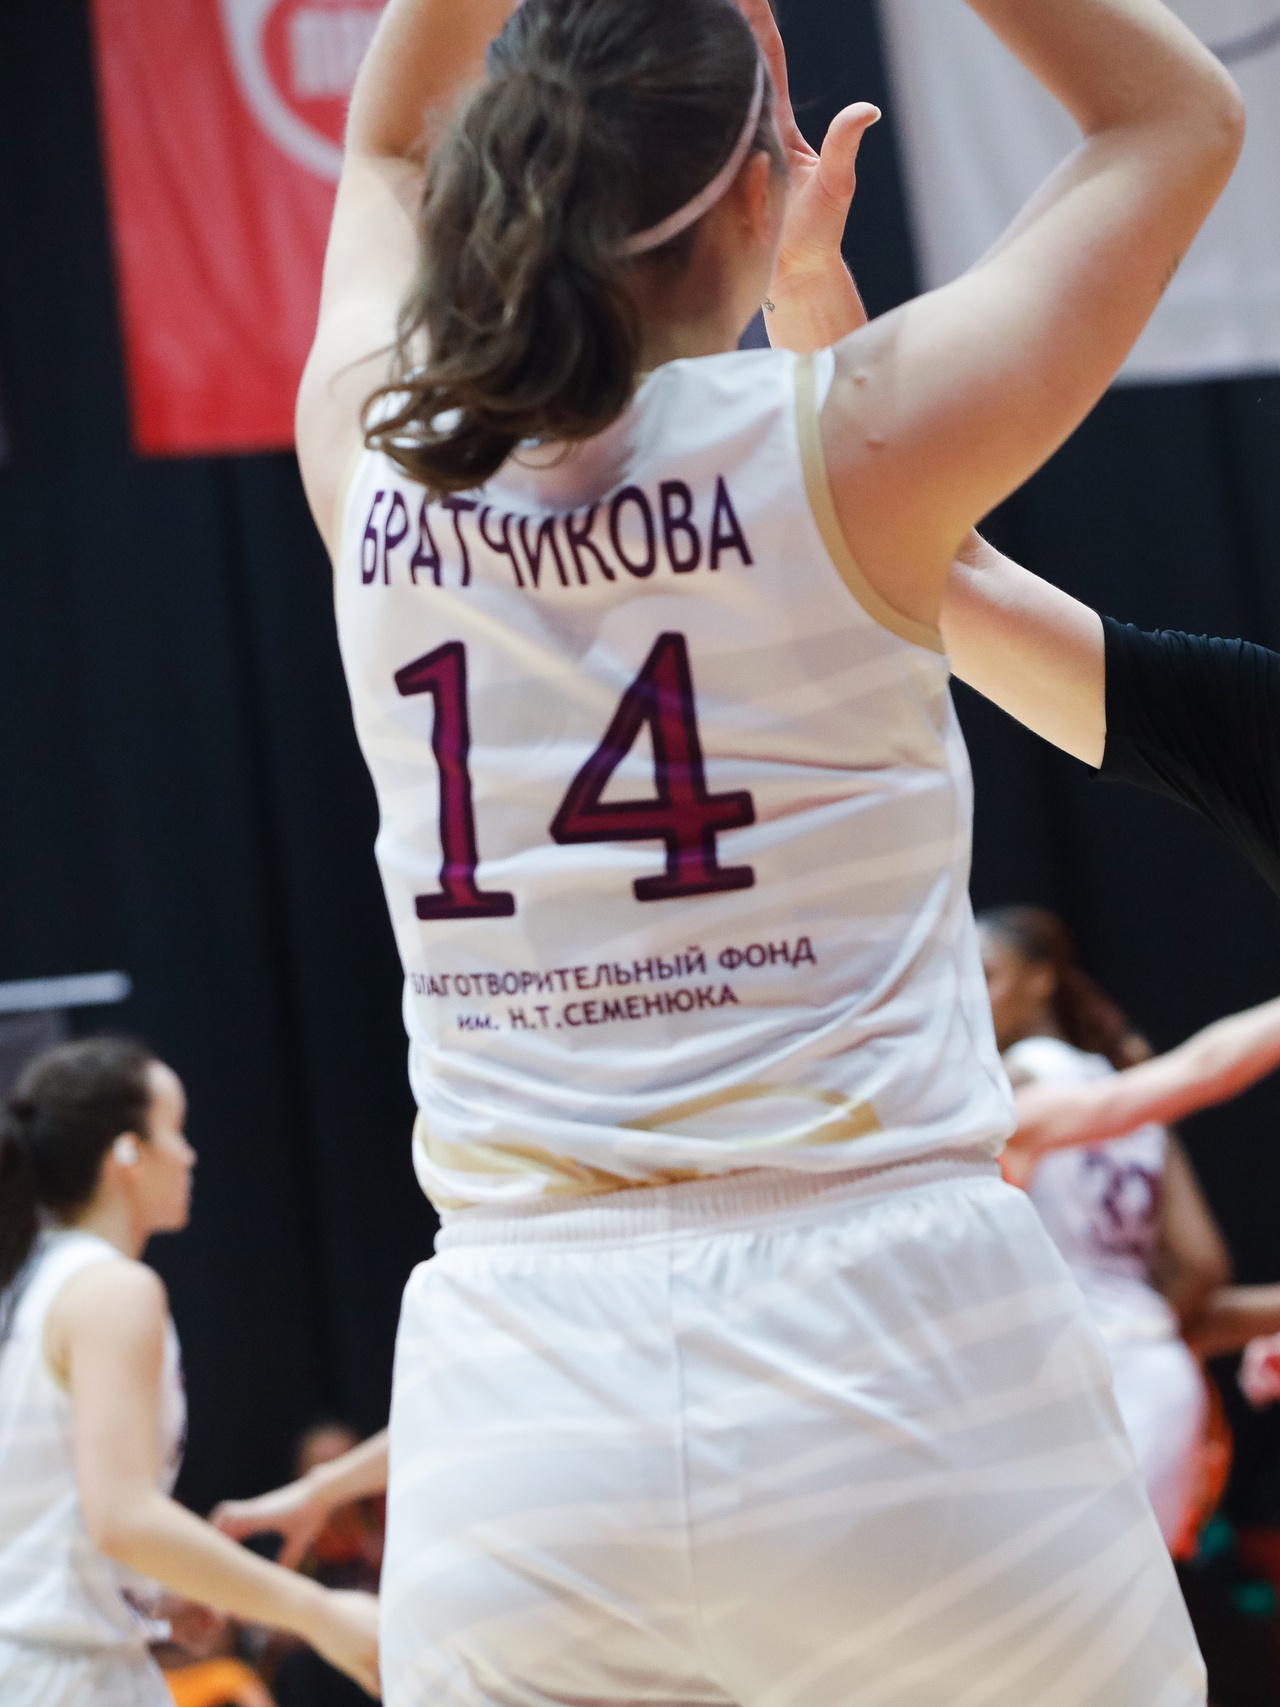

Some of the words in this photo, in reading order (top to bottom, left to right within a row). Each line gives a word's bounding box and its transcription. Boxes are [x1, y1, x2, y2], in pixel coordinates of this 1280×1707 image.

[362, 474, 753, 588] БРАТЧИКОВА
[394, 631, 755, 920] 14
[718, 935, 817, 971] ФОНД
